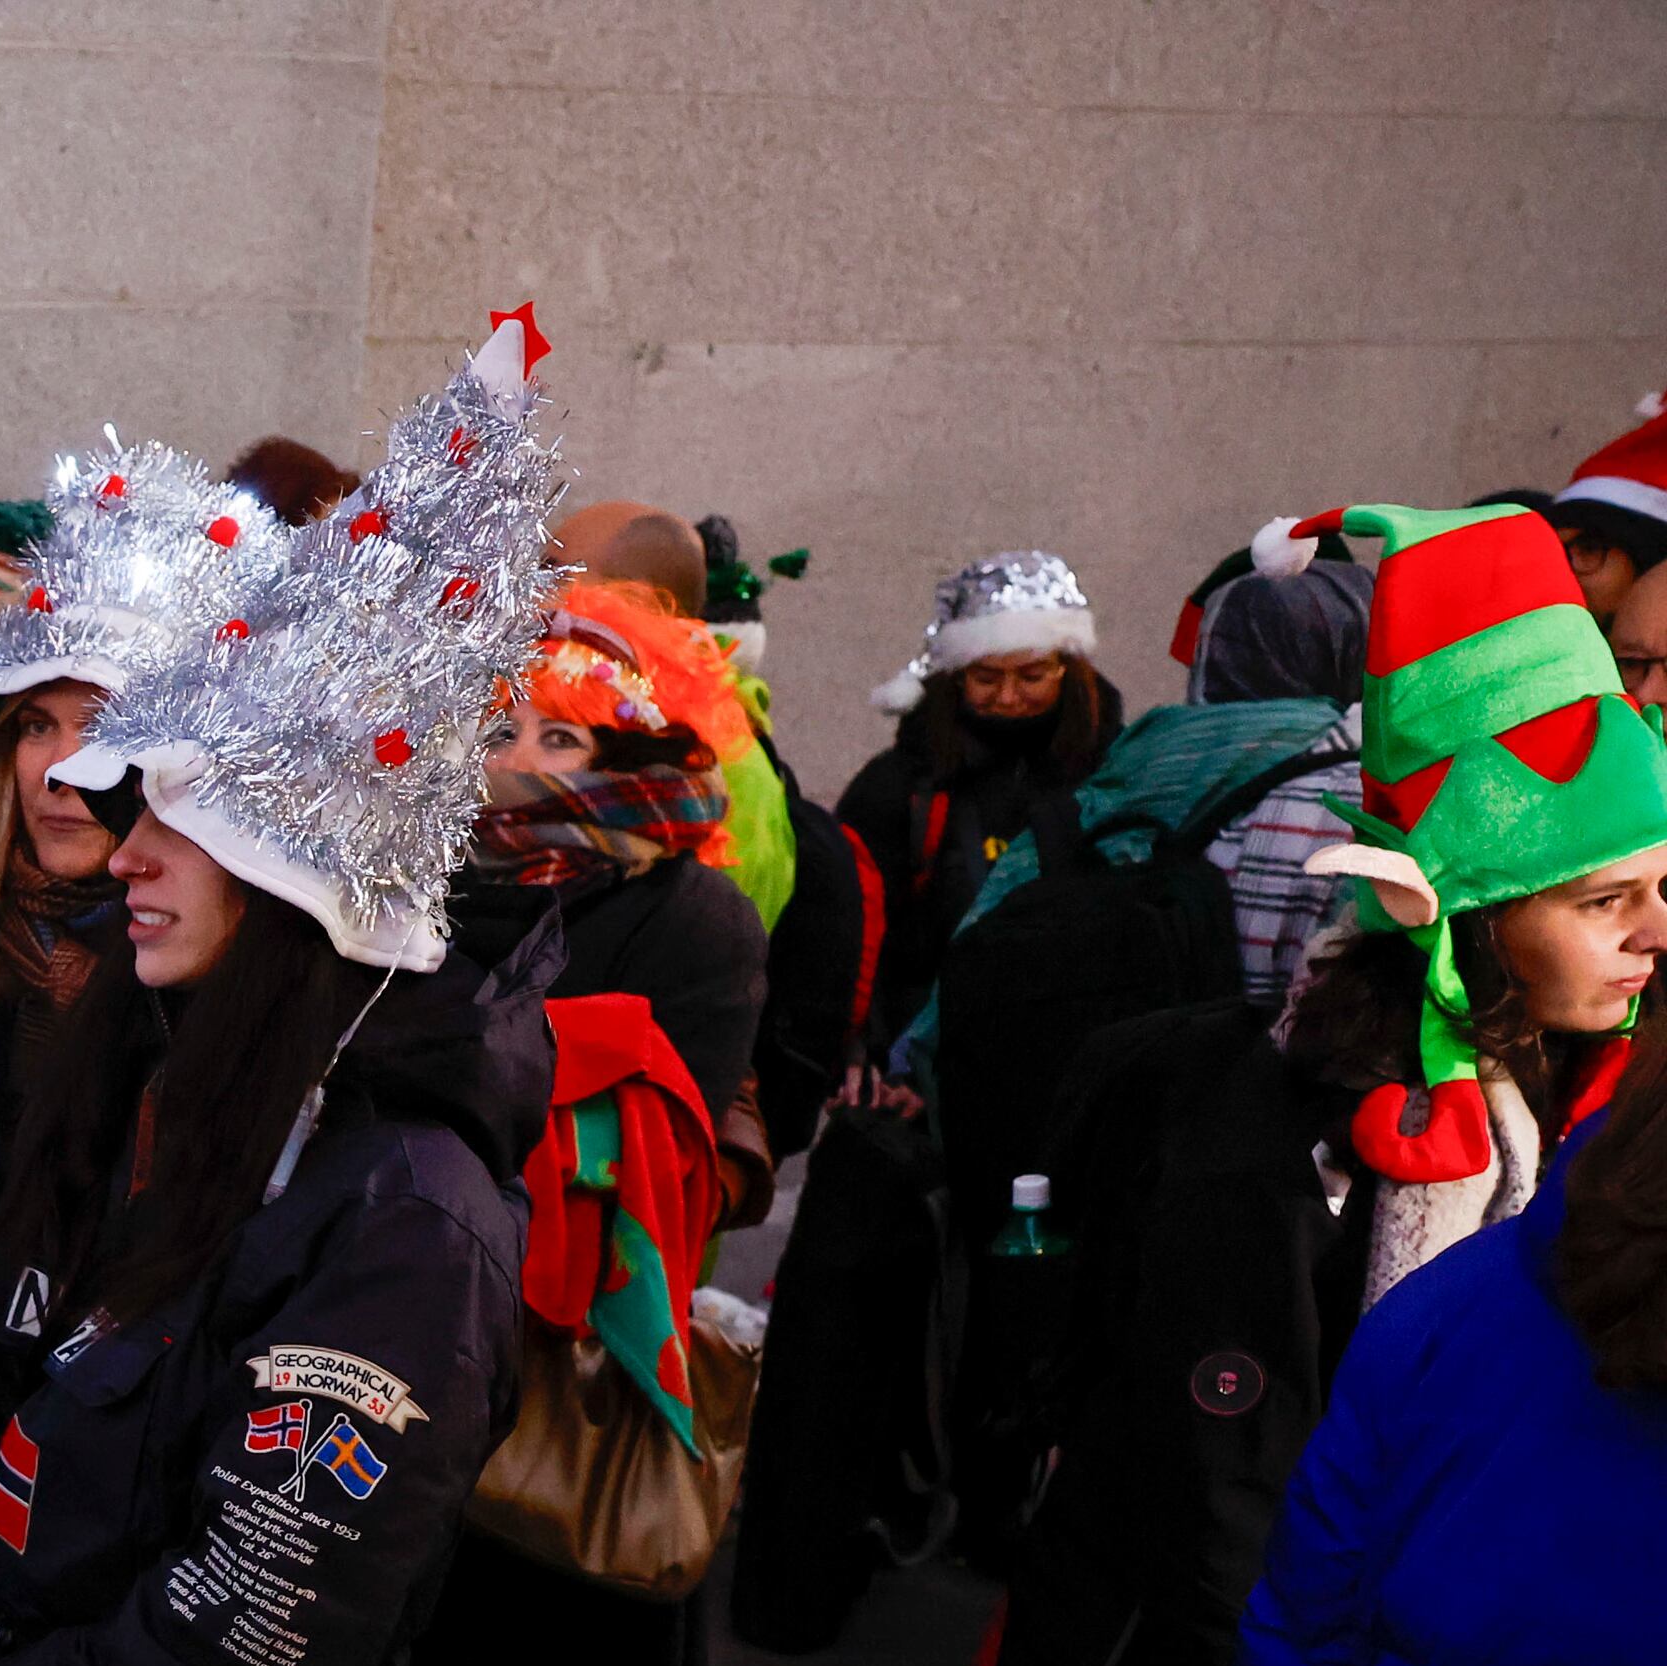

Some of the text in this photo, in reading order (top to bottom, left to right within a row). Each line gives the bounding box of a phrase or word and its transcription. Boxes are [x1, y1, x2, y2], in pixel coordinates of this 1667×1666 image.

[275, 1353, 396, 1404] GEOGRAPHICAL
[275, 1372, 386, 1415] 19 NORWAY 53
[211, 1465, 362, 1541] Polar Expedition since 1953
[251, 1499, 303, 1531] Equipment
[223, 1500, 320, 1553] Original Artic clothes
[250, 1531, 270, 1544] for
[203, 1576, 231, 1602] country
[230, 1566, 240, 1578] to
[239, 1572, 255, 1587] the
[255, 1582, 278, 1599] west
[277, 1593, 299, 1608] and
[232, 1581, 245, 1596] the
[238, 1556, 259, 1573] land
[259, 1568, 295, 1592] borders
[296, 1586, 318, 1601] with
[233, 1615, 274, 1645] Oresund
